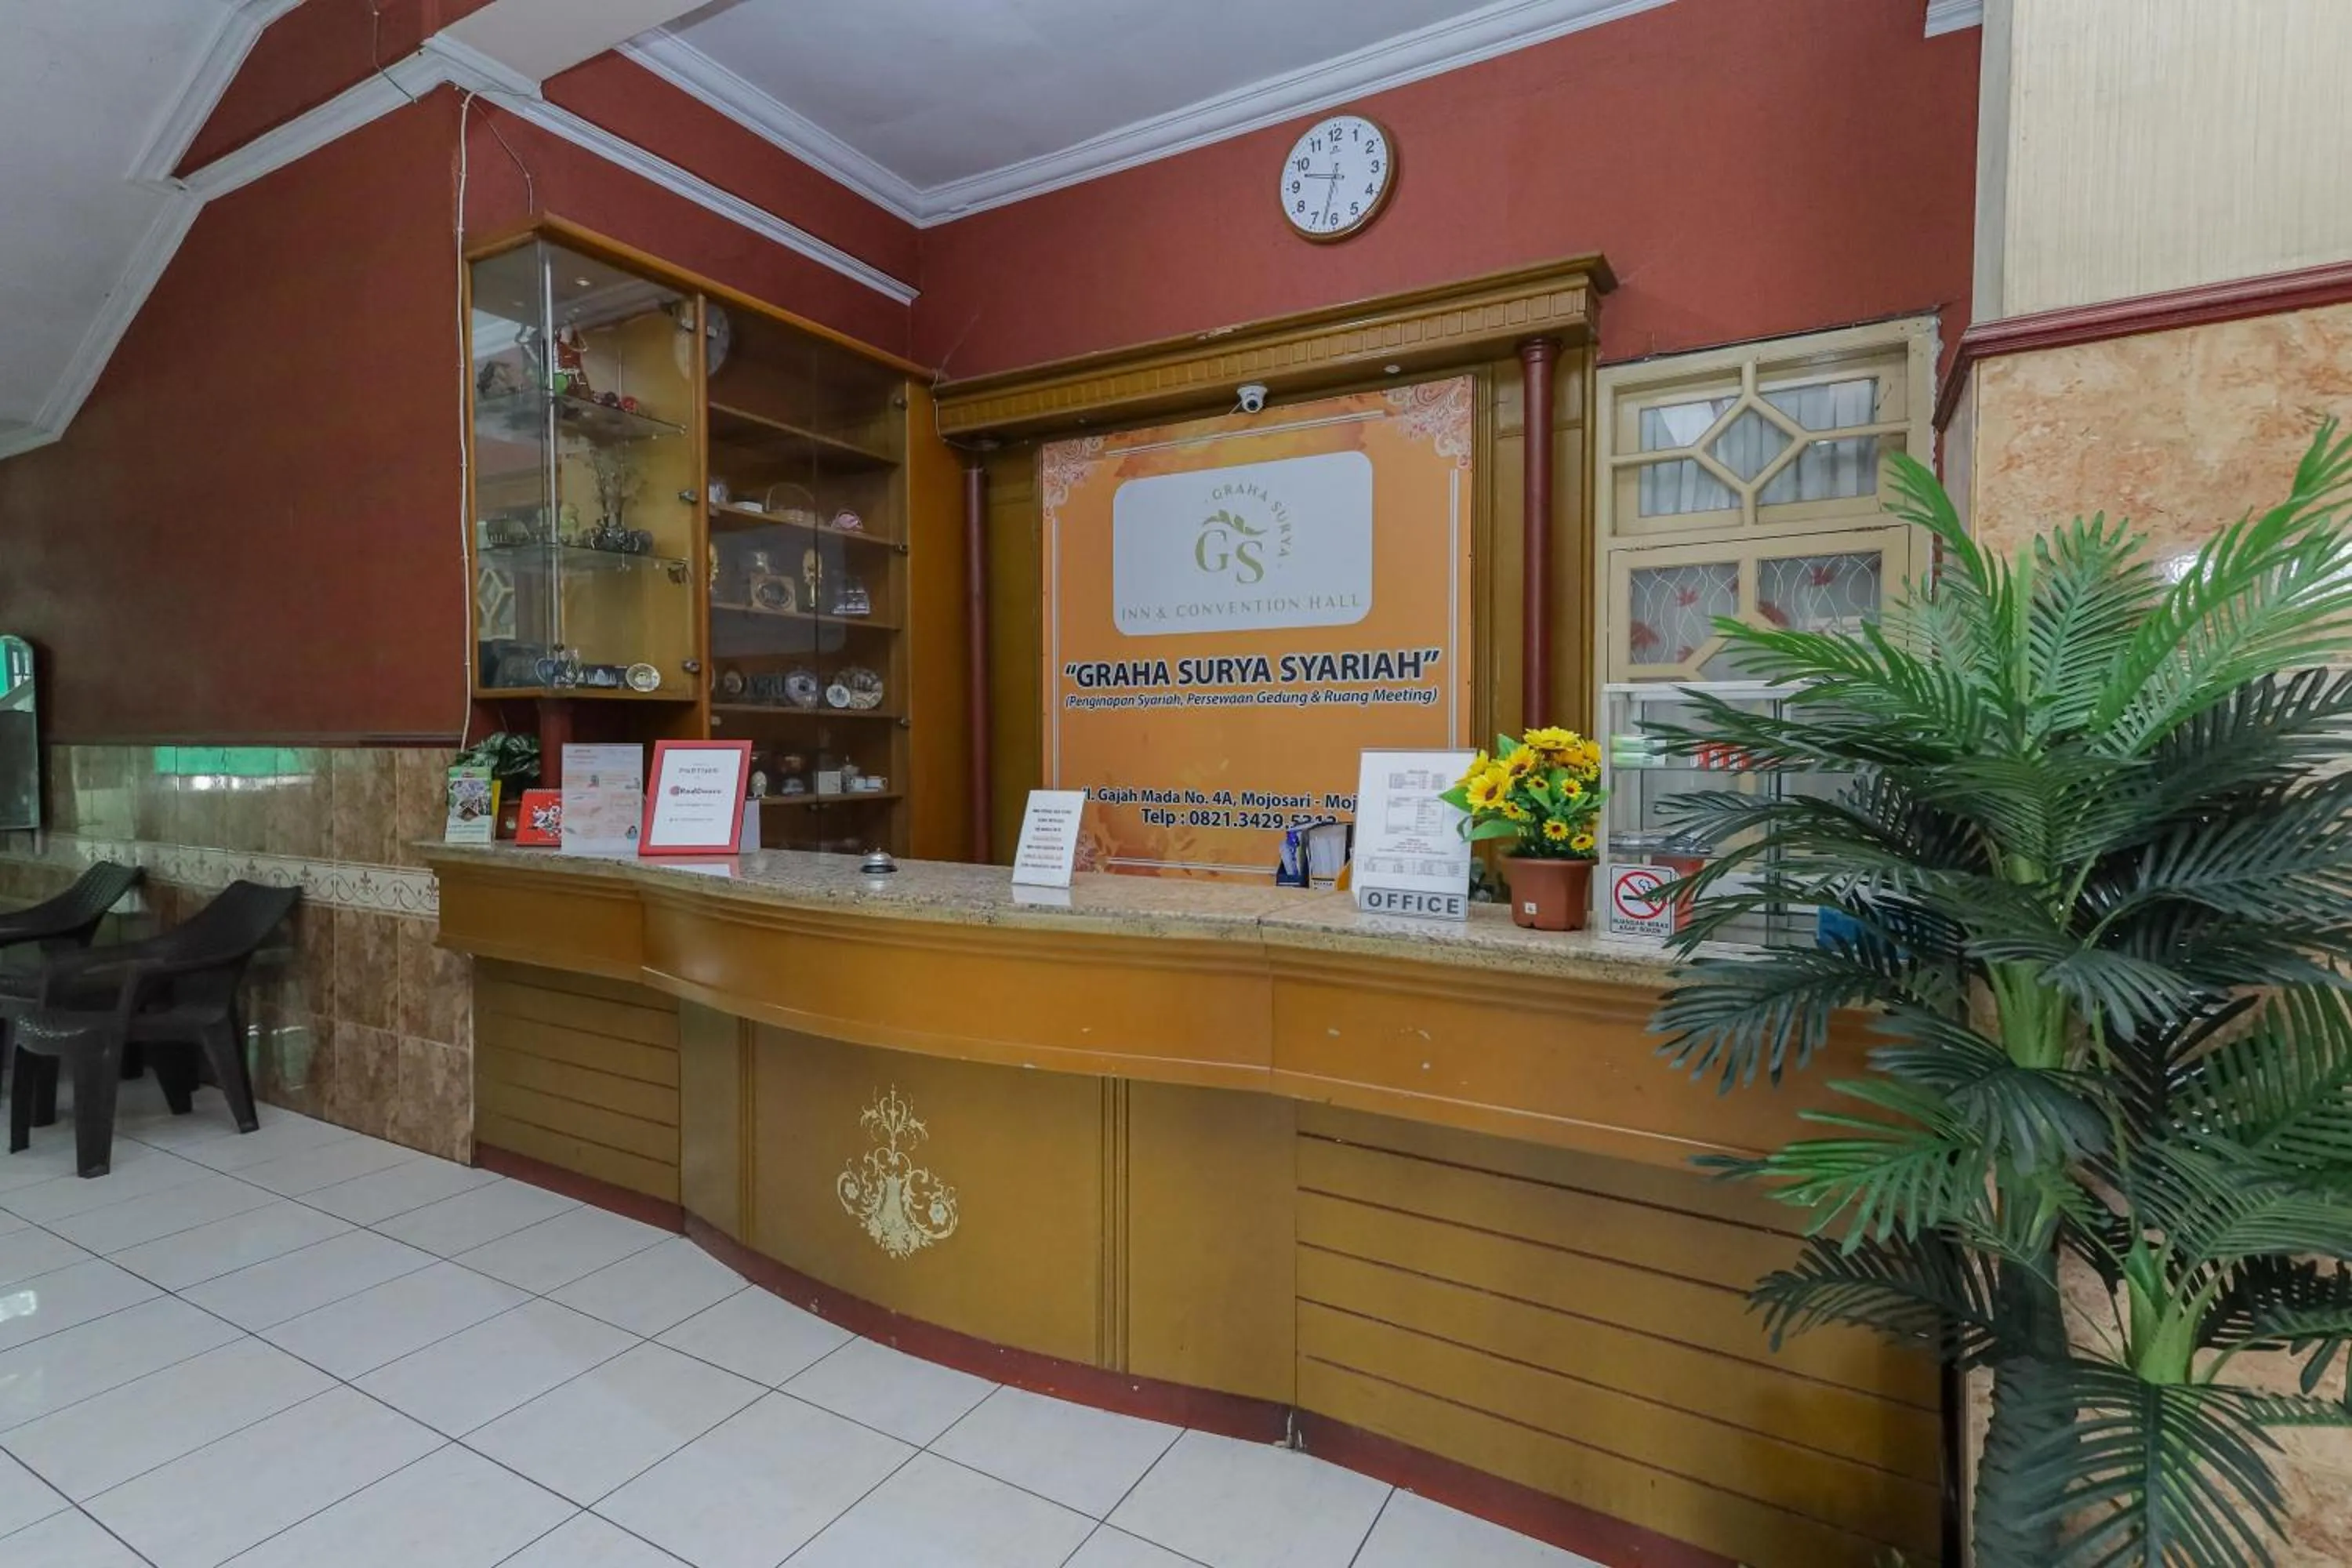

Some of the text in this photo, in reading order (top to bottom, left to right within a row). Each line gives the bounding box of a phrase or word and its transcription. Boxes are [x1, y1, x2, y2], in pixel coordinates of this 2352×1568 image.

[1328, 128, 1343, 142] 12
[1352, 129, 1359, 142] 1
[1310, 139, 1322, 153] 11
[1365, 140, 1375, 154] 2
[1296, 157, 1310, 172] 10
[1370, 159, 1380, 173] 3
[1291, 180, 1301, 194] 9
[1364, 183, 1374, 195] 4
[1296, 200, 1305, 213] 8
[1349, 201, 1359, 216] 5
[1310, 211, 1319, 225] 7
[1330, 212, 1338, 226] 6
[1211, 483, 1268, 503] GRAHA
[1194, 528, 1265, 584] GS
[1121, 593, 1360, 622] INN & CONVENTION HALL
[1178, 658, 1272, 684] SURYA
[1065, 687, 1438, 710] (Penginapan Syariah, Persewaan Gedung & Ruang Meeting)
[1083, 787, 1094, 800] l.
[1098, 788, 1138, 804] Gajah
[1142, 789, 1181, 804] Mada
[1185, 791, 1209, 804] No.
[1213, 791, 1236, 806] 4A,
[1241, 792, 1311, 810] Mojosari
[1326, 794, 1357, 813] Moj
[1142, 808, 1176, 828] Telp
[1367, 891, 1461, 915] OFFICE
